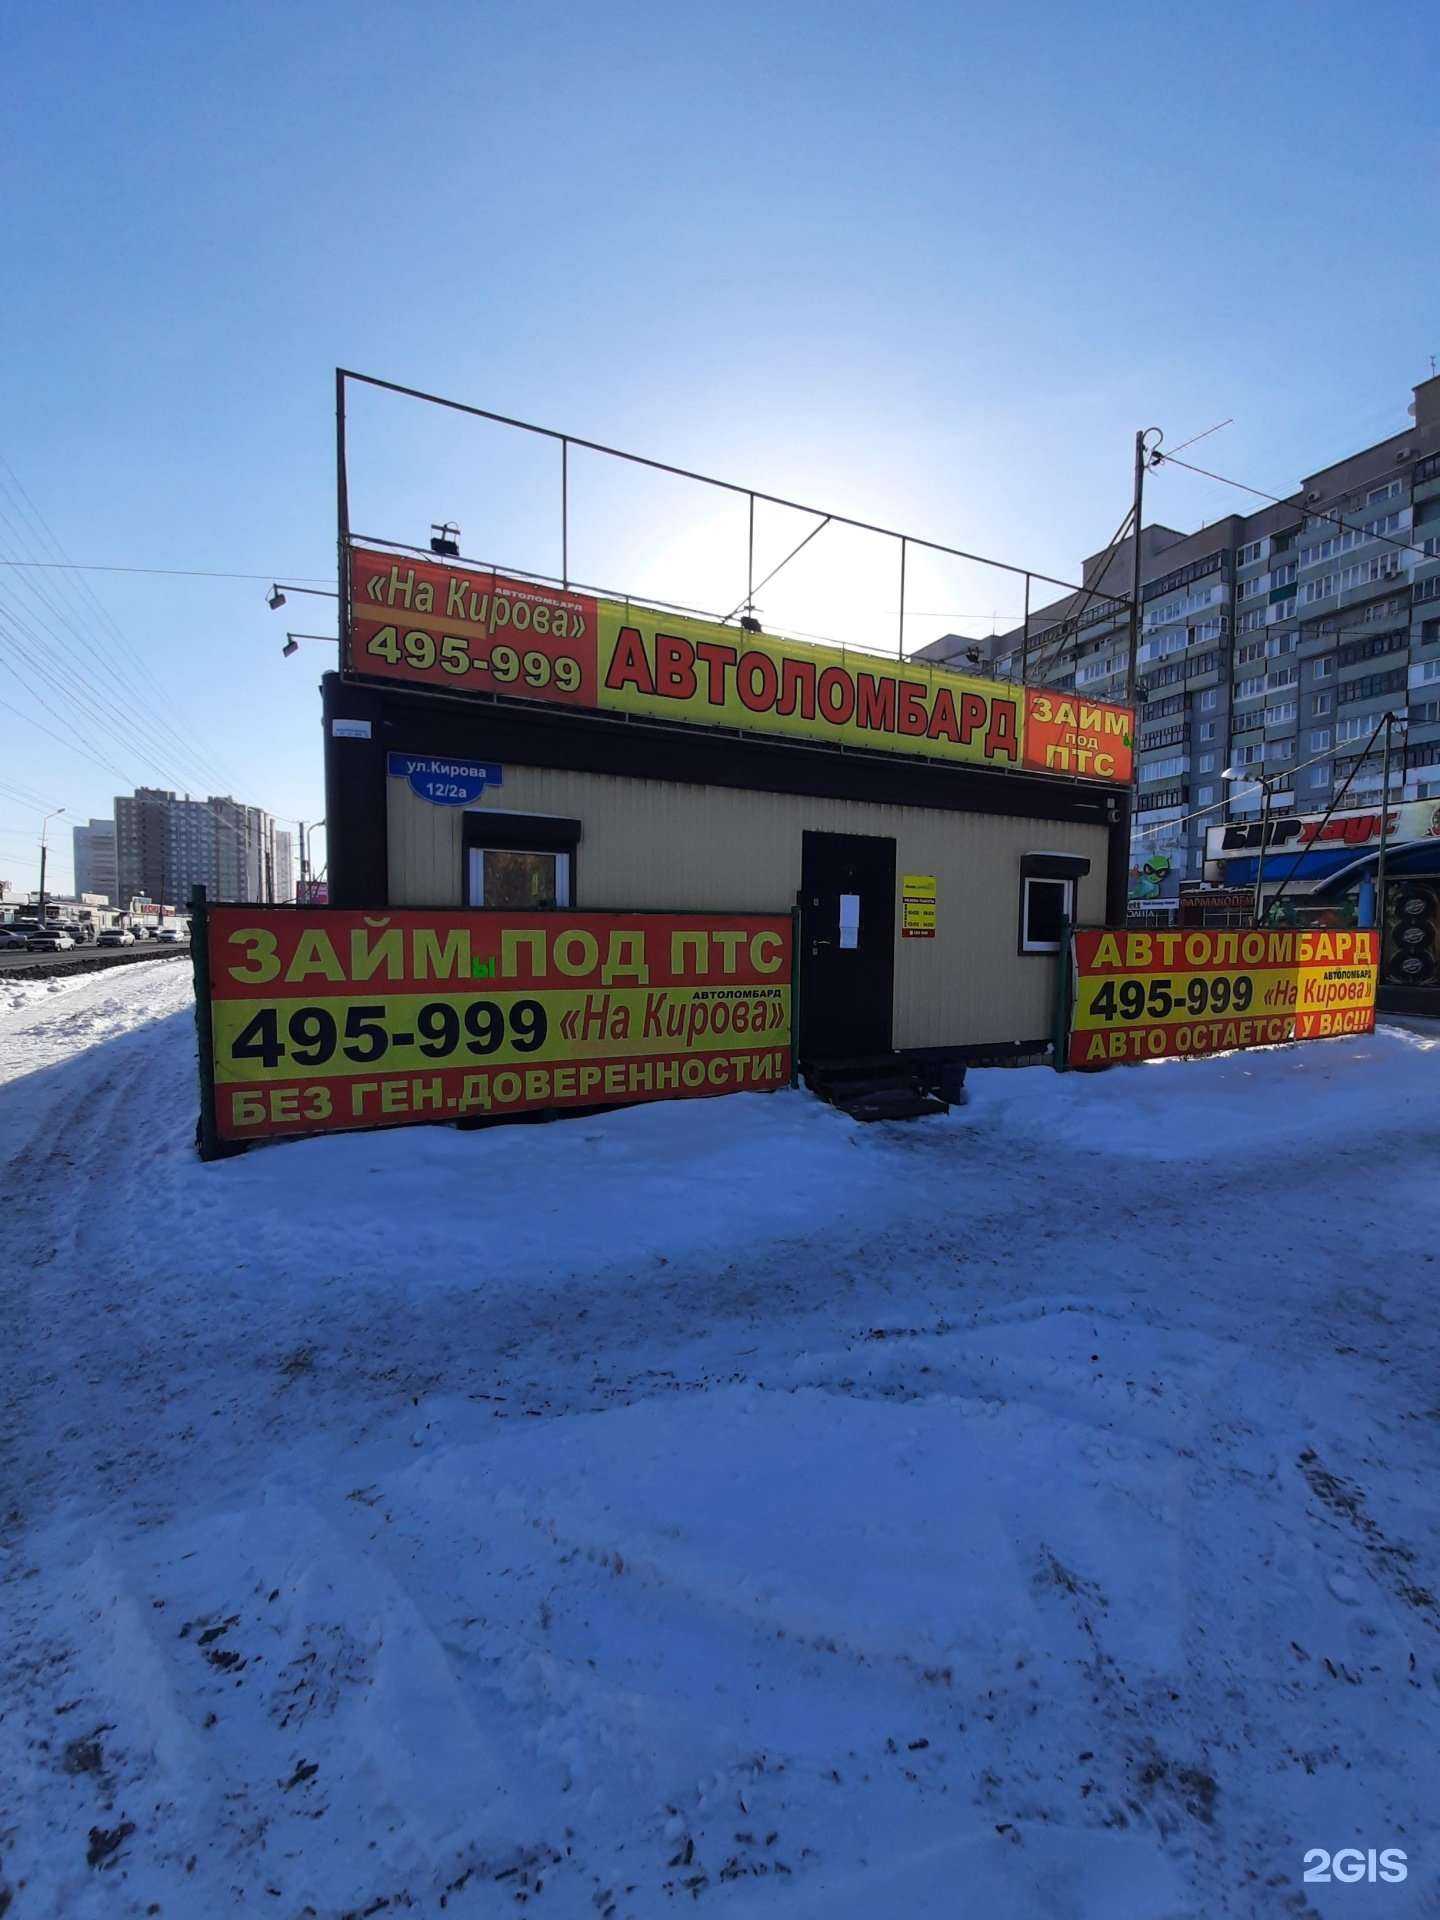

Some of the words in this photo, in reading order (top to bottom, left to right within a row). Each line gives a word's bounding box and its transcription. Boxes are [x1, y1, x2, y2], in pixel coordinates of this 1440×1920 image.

[366, 566, 434, 613] «На
[446, 577, 587, 640] Кирова»
[494, 586, 583, 612] АВТОЛОМБАРД
[366, 625, 582, 693] 495-999
[604, 625, 1018, 763] АВТОЛОМБАРД
[407, 760, 487, 778] ул.Кирова
[1046, 743, 1115, 777] ПТС
[426, 782, 467, 799] 12/2а
[501, 929, 650, 985] ПОД
[671, 930, 783, 975] ПТС
[1090, 932, 1371, 967] АВТОЛОМБАРД
[692, 988, 782, 999] АВТОЛОМБАРД
[1090, 976, 1253, 1020] 495-999
[1263, 979, 1298, 1007] «На
[1303, 978, 1372, 1009] Кирова»
[231, 1000, 548, 1067] 495-999
[559, 994, 630, 1042] «На
[642, 993, 785, 1047] Кирова»
[1086, 1027, 1167, 1061] АВТО
[1175, 1017, 1296, 1049] ОСТАЕТСЯ
[1301, 1015, 1314, 1037] У
[1319, 1010, 1370, 1036] ВАС!!!
[232, 1086, 333, 1127] БЕЗ
